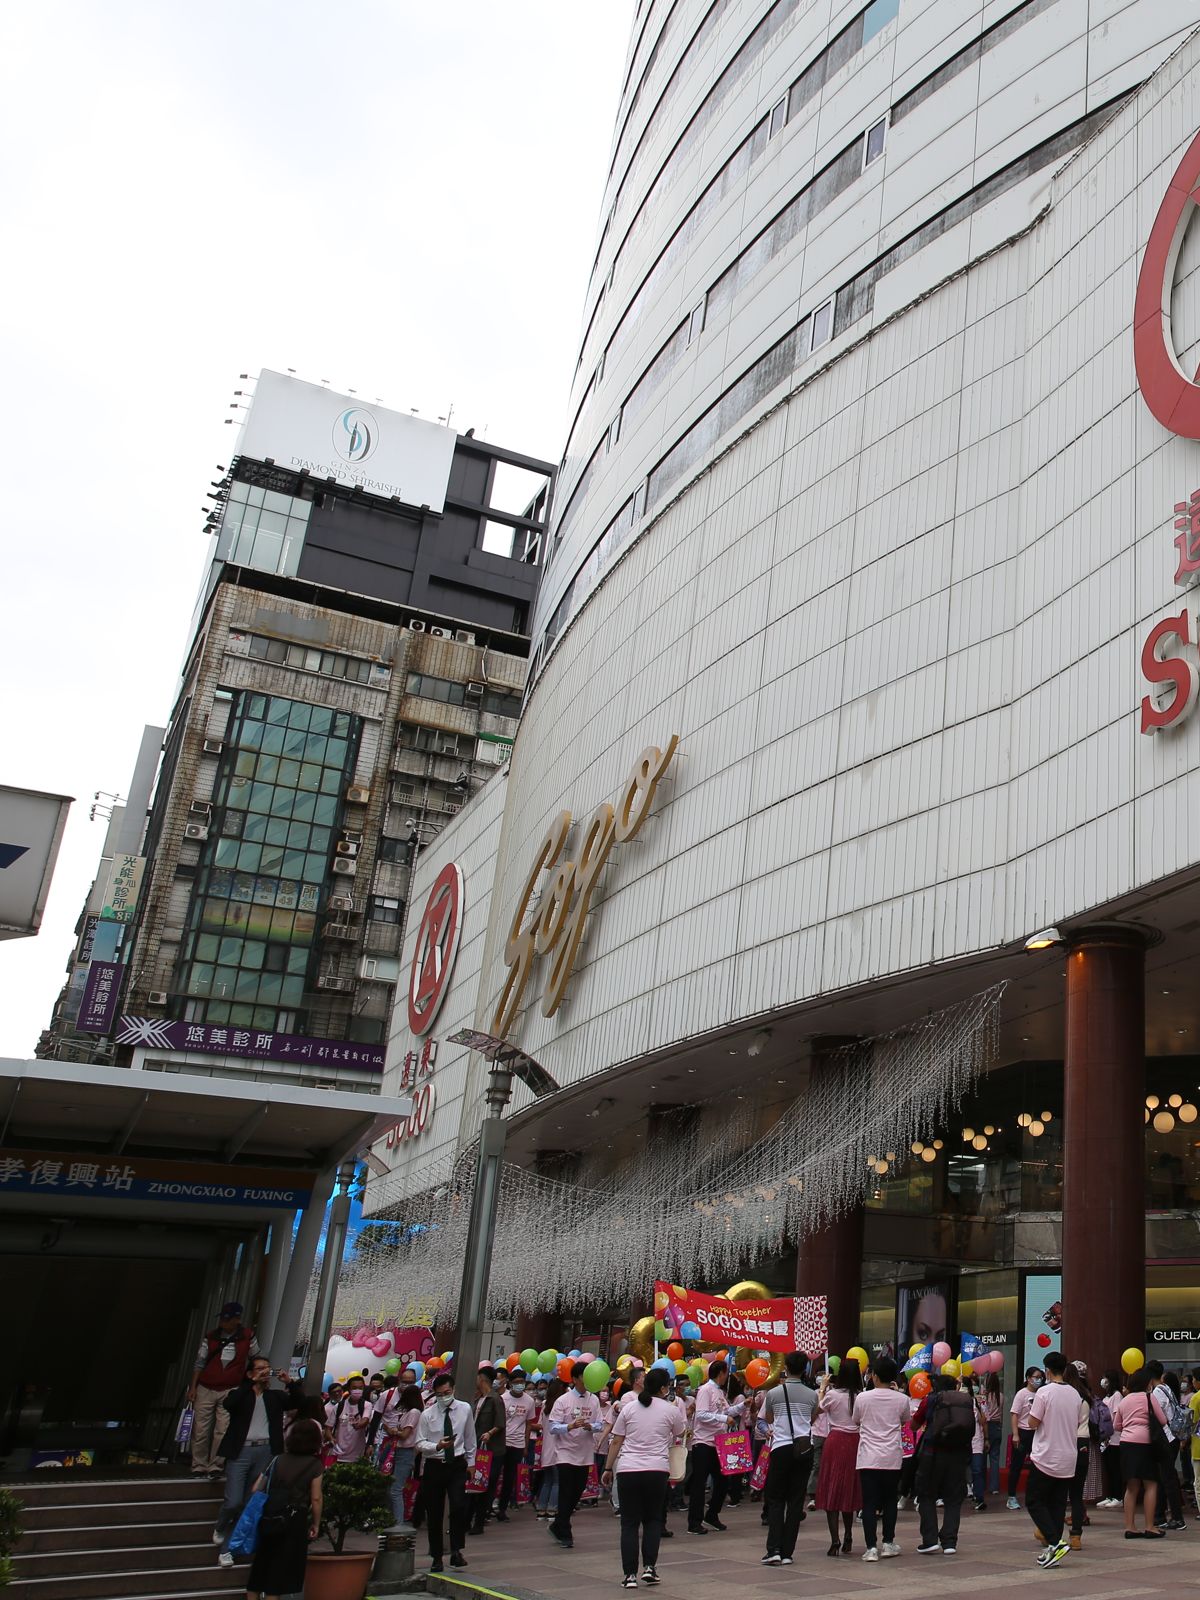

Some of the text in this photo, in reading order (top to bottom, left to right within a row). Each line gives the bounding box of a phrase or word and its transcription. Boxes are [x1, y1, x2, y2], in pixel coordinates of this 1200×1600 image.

[291, 456, 403, 496] DIAMOND SHIRAISHI
[331, 461, 367, 475] GINZA
[116, 911, 132, 921] 8F
[93, 968, 115, 1015] 悠美診所
[186, 1026, 273, 1050] 悠美診所
[386, 1084, 434, 1149] GO
[0, 1157, 136, 1191] 孝復興站
[147, 1182, 295, 1202] ZHONGXIAO FUXING
[696, 1309, 788, 1336] SOGO 週年慶
[709, 1305, 771, 1320] Happy Together
